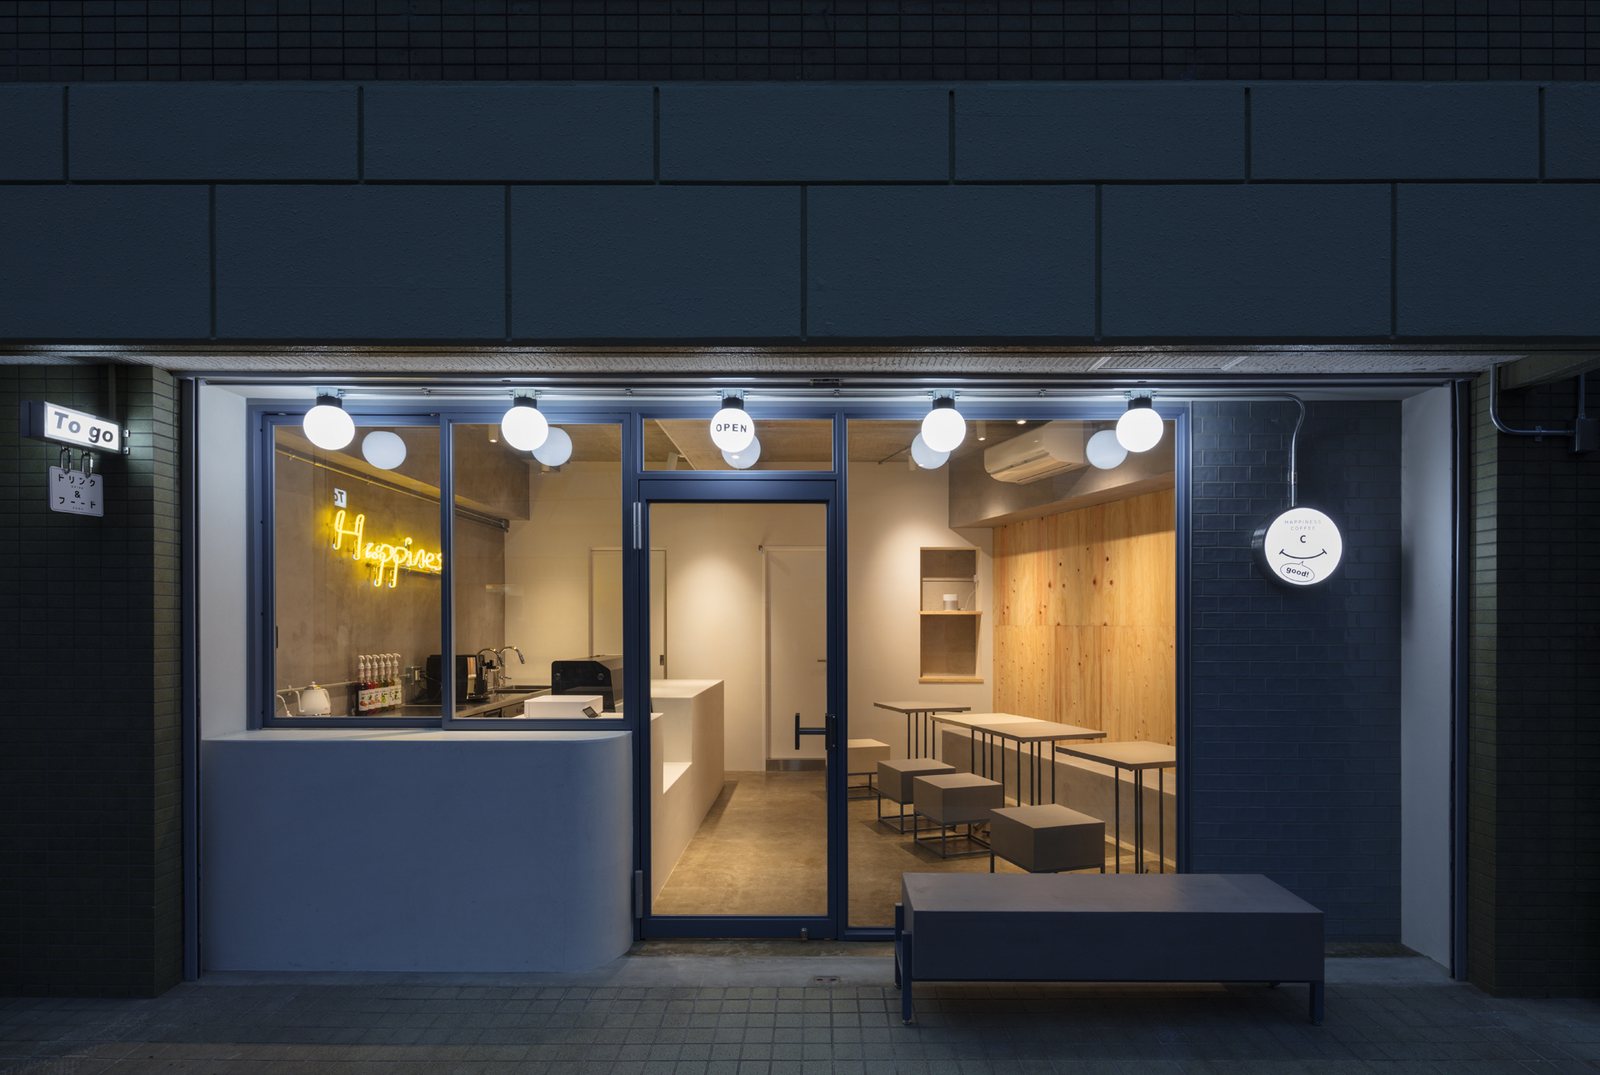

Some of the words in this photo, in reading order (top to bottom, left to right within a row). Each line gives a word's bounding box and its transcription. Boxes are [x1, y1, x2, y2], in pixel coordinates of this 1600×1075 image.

[54, 411, 81, 433] To
[88, 426, 114, 443] go
[715, 423, 747, 432] OPEN
[74, 490, 81, 499] &
[1286, 567, 1310, 578] good!
